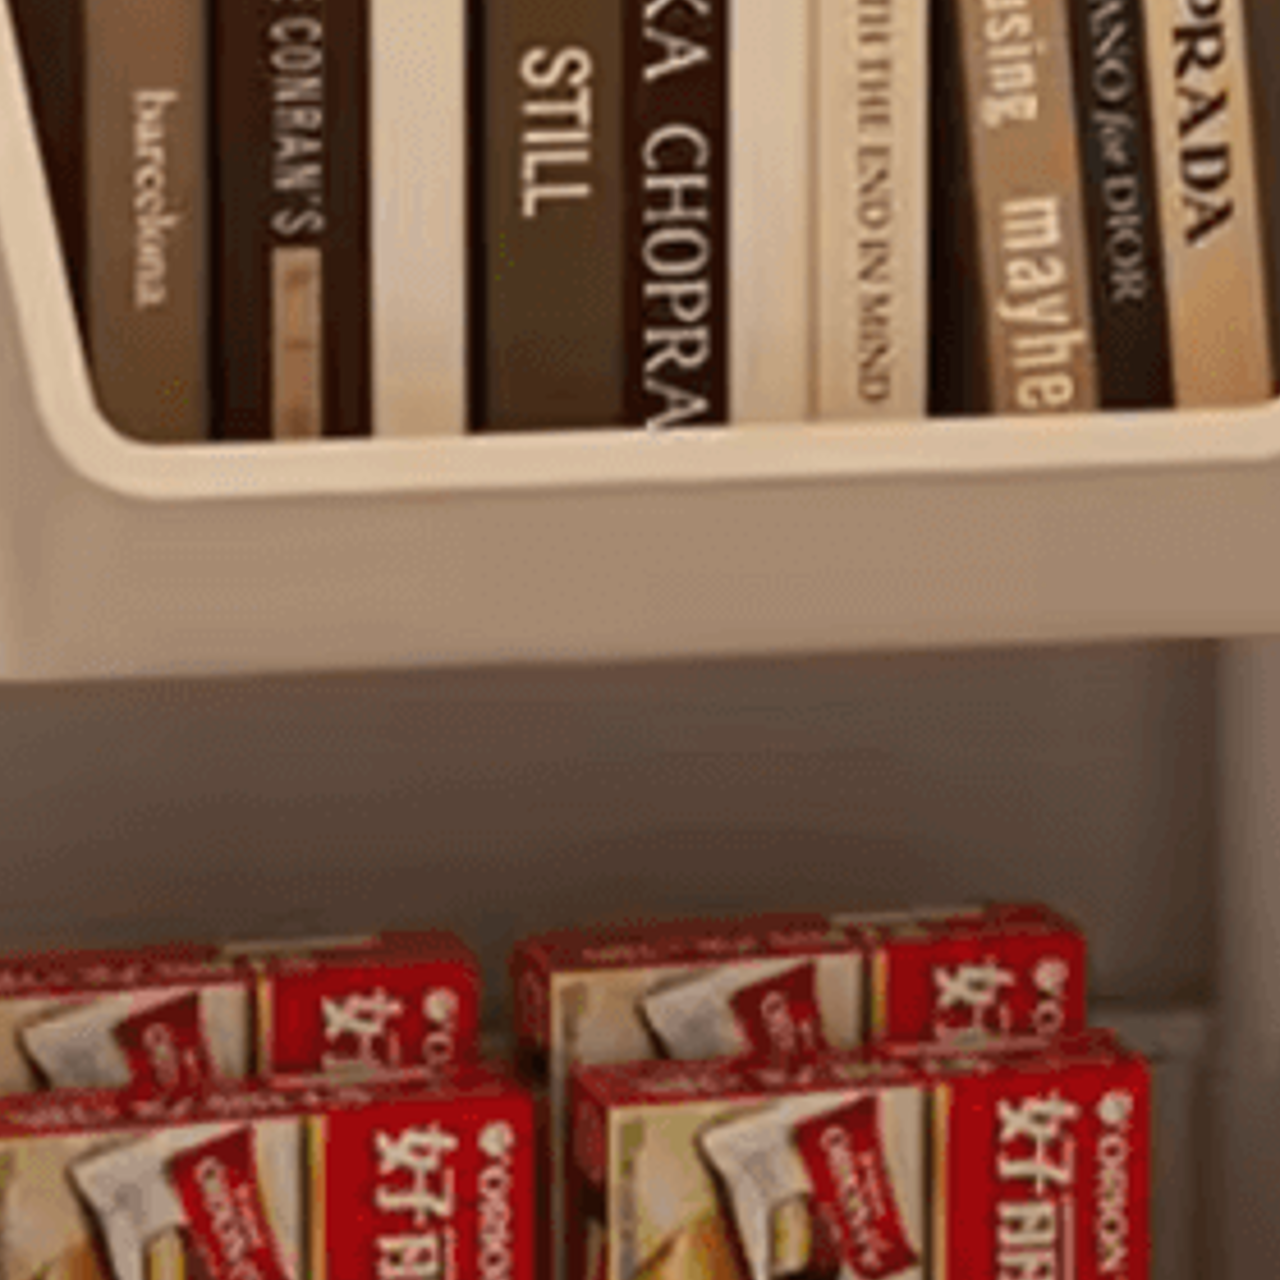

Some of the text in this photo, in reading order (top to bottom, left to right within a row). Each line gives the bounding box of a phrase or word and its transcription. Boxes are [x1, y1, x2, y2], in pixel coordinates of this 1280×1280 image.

[270, 16, 326, 237] CONRAN'S
[521, 45, 594, 219] STILL
[857, 54, 893, 136] THE
[1093, 109, 1133, 166] for
[132, 87, 180, 311] barcelona
[857, 146, 892, 230] END
[1103, 174, 1148, 304] DIOR
[641, 122, 710, 436] CHOPRA
[857, 240, 892, 282] IN
[857, 293, 893, 405] MIND
[1099, 1136, 1129, 1276] ORION
